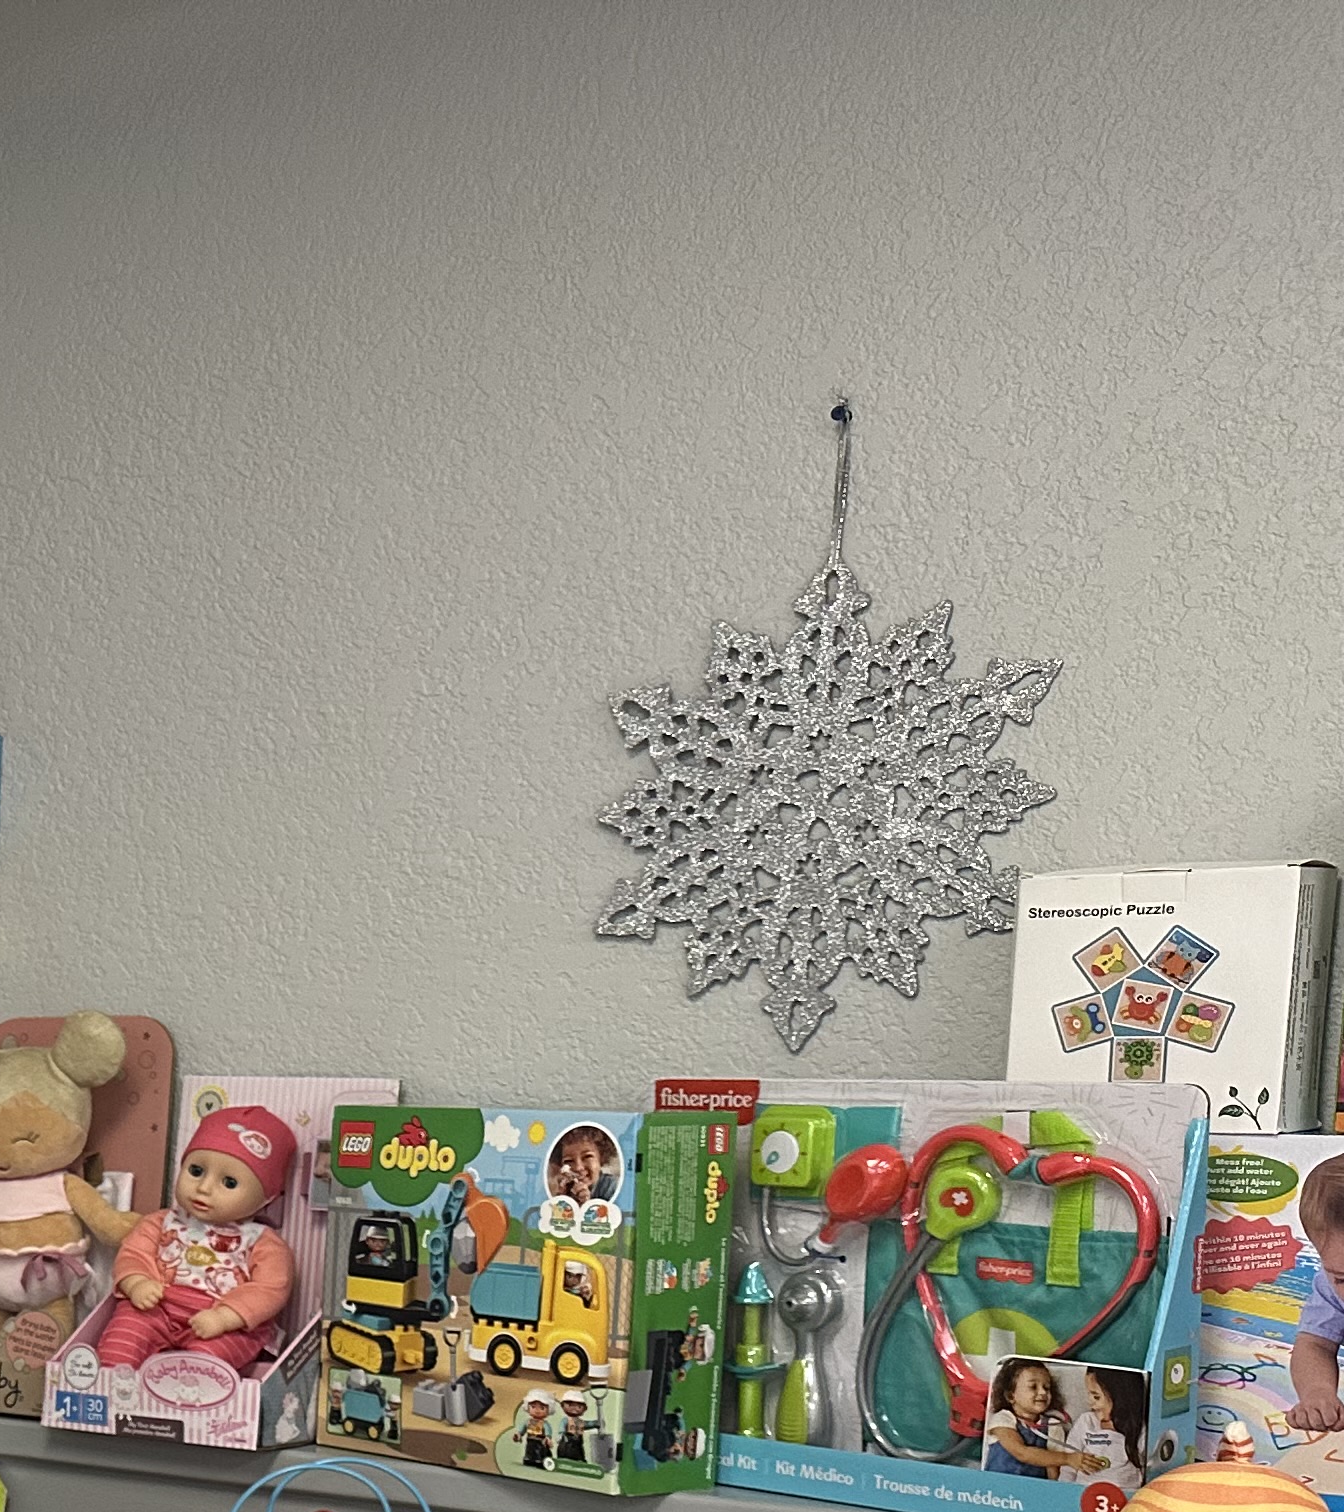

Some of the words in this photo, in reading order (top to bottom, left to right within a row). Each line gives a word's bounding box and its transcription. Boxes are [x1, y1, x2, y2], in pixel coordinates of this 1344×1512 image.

[1028, 903, 1123, 922] Stereoscopic
[1126, 902, 1175, 917] Puzzle
[660, 1088, 753, 1111] fisher-price
[342, 1134, 372, 1153] LEGO
[379, 1136, 456, 1177] duplo
[704, 1160, 723, 1225] duplo
[737, 1452, 757, 1471] Kit
[775, 1459, 796, 1476] Kit
[799, 1462, 854, 1486] Médico
[874, 1473, 931, 1498] Trousse
[934, 1484, 954, 1500] de
[957, 1487, 1023, 1512] médecin
